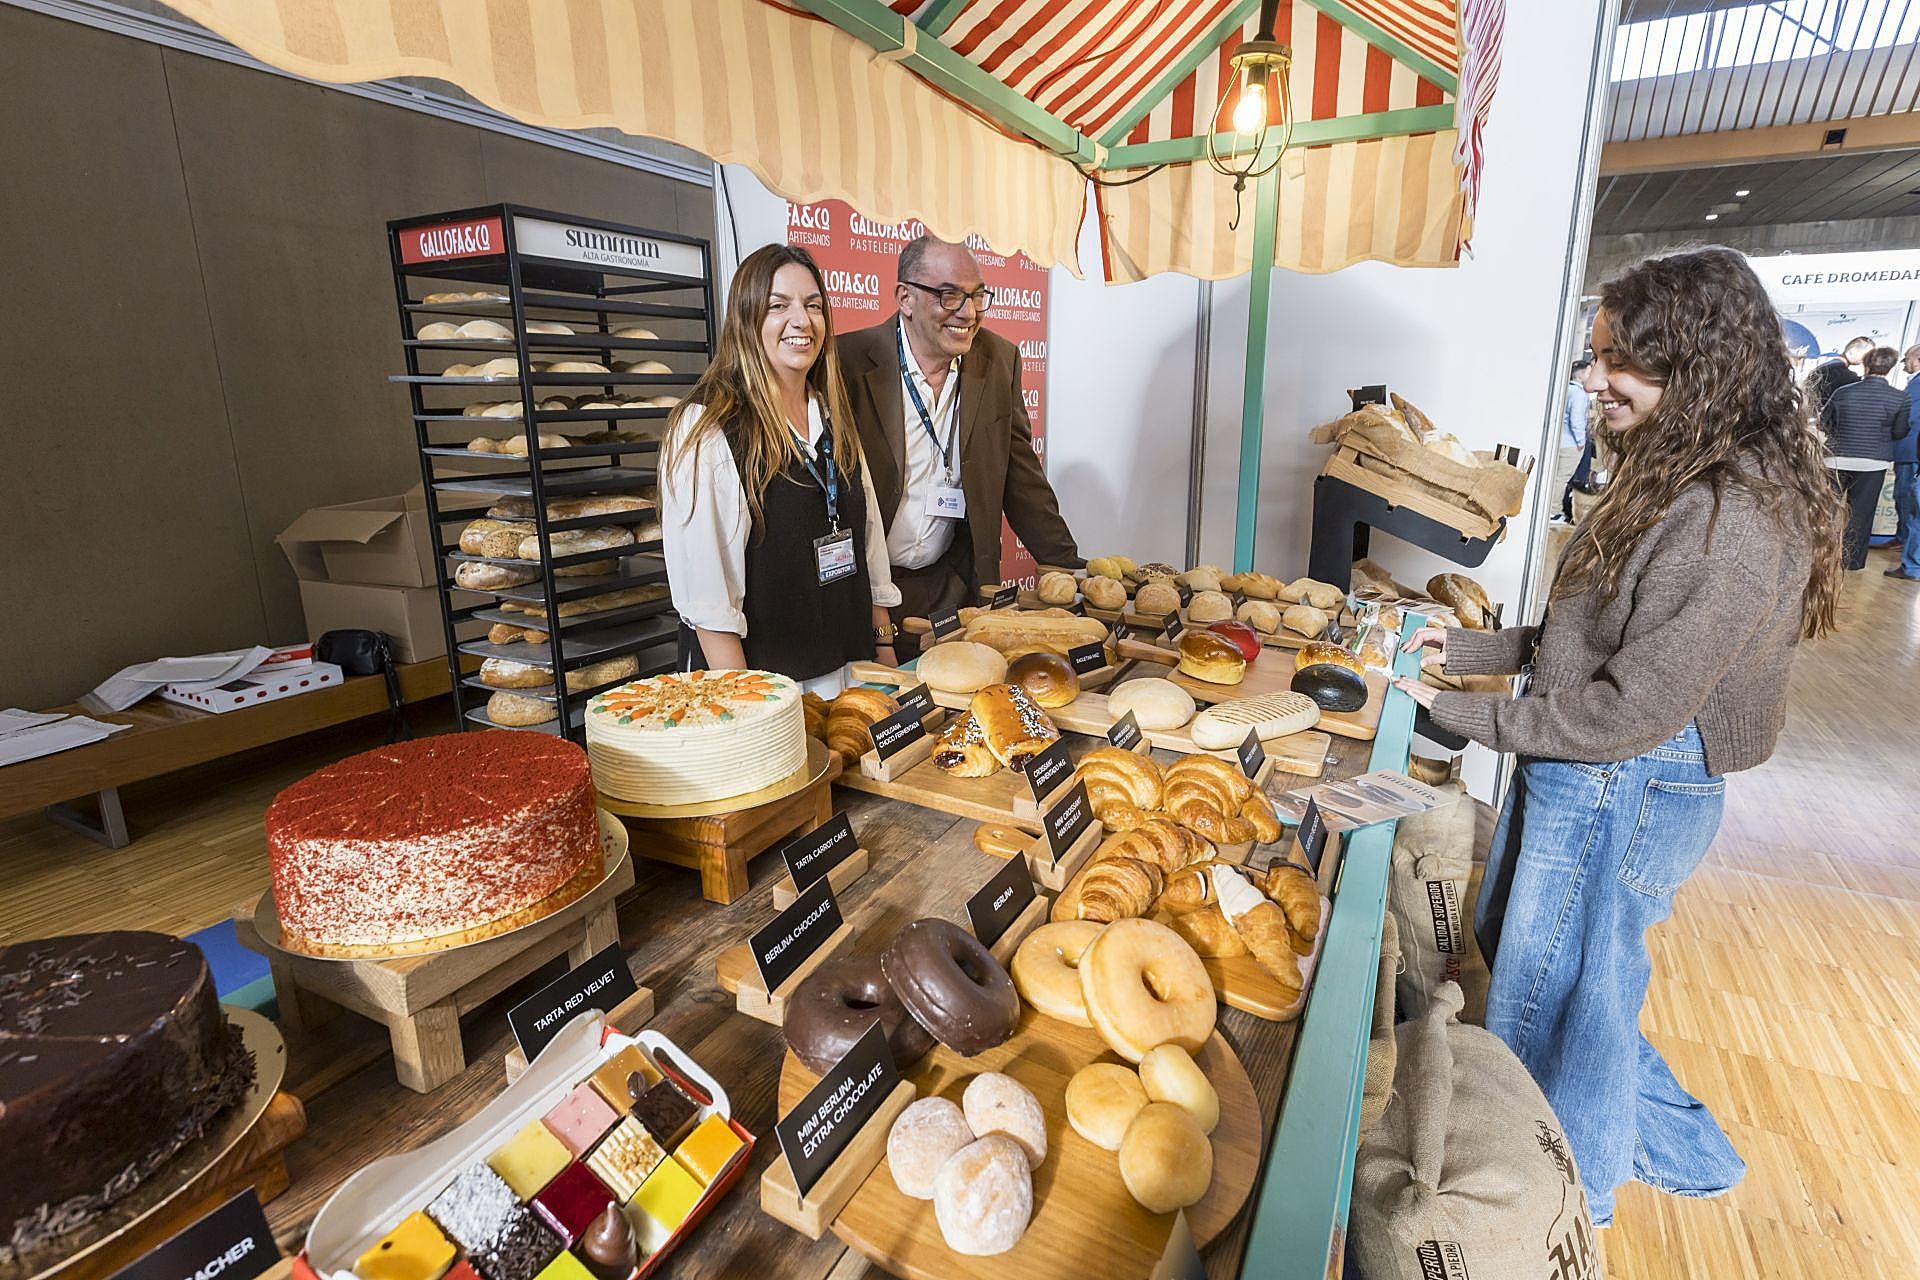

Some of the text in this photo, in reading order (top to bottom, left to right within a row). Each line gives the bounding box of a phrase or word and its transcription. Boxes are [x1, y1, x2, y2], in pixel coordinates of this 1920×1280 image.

[419, 224, 490, 257] GALLOFA&CO
[788, 231, 831, 247] ARTESANOS
[582, 251, 600, 262] ALTA
[824, 270, 879, 296] LOFA&CO
[842, 296, 880, 311] ARTESANOS
[879, 736, 896, 749] CHOCO
[1033, 758, 1053, 779] CROISSANT
[1063, 795, 1082, 821] CROISSANT
[795, 828, 849, 870] TARTA CARROT CAKE
[993, 886, 1014, 911] BERLINA
[1428, 882, 1446, 919] SUPERIOR
[764, 900, 831, 965] BERLINA CHOCOLATE
[1437, 920, 1450, 951] CALIDAD
[534, 969, 616, 1032] TARTA RED VELVET
[797, 1077, 855, 1143] MINI BERLINA
[802, 1062, 884, 1159] EXTRA CHOCOLATE
[184, 1236, 256, 1280] ACHER
